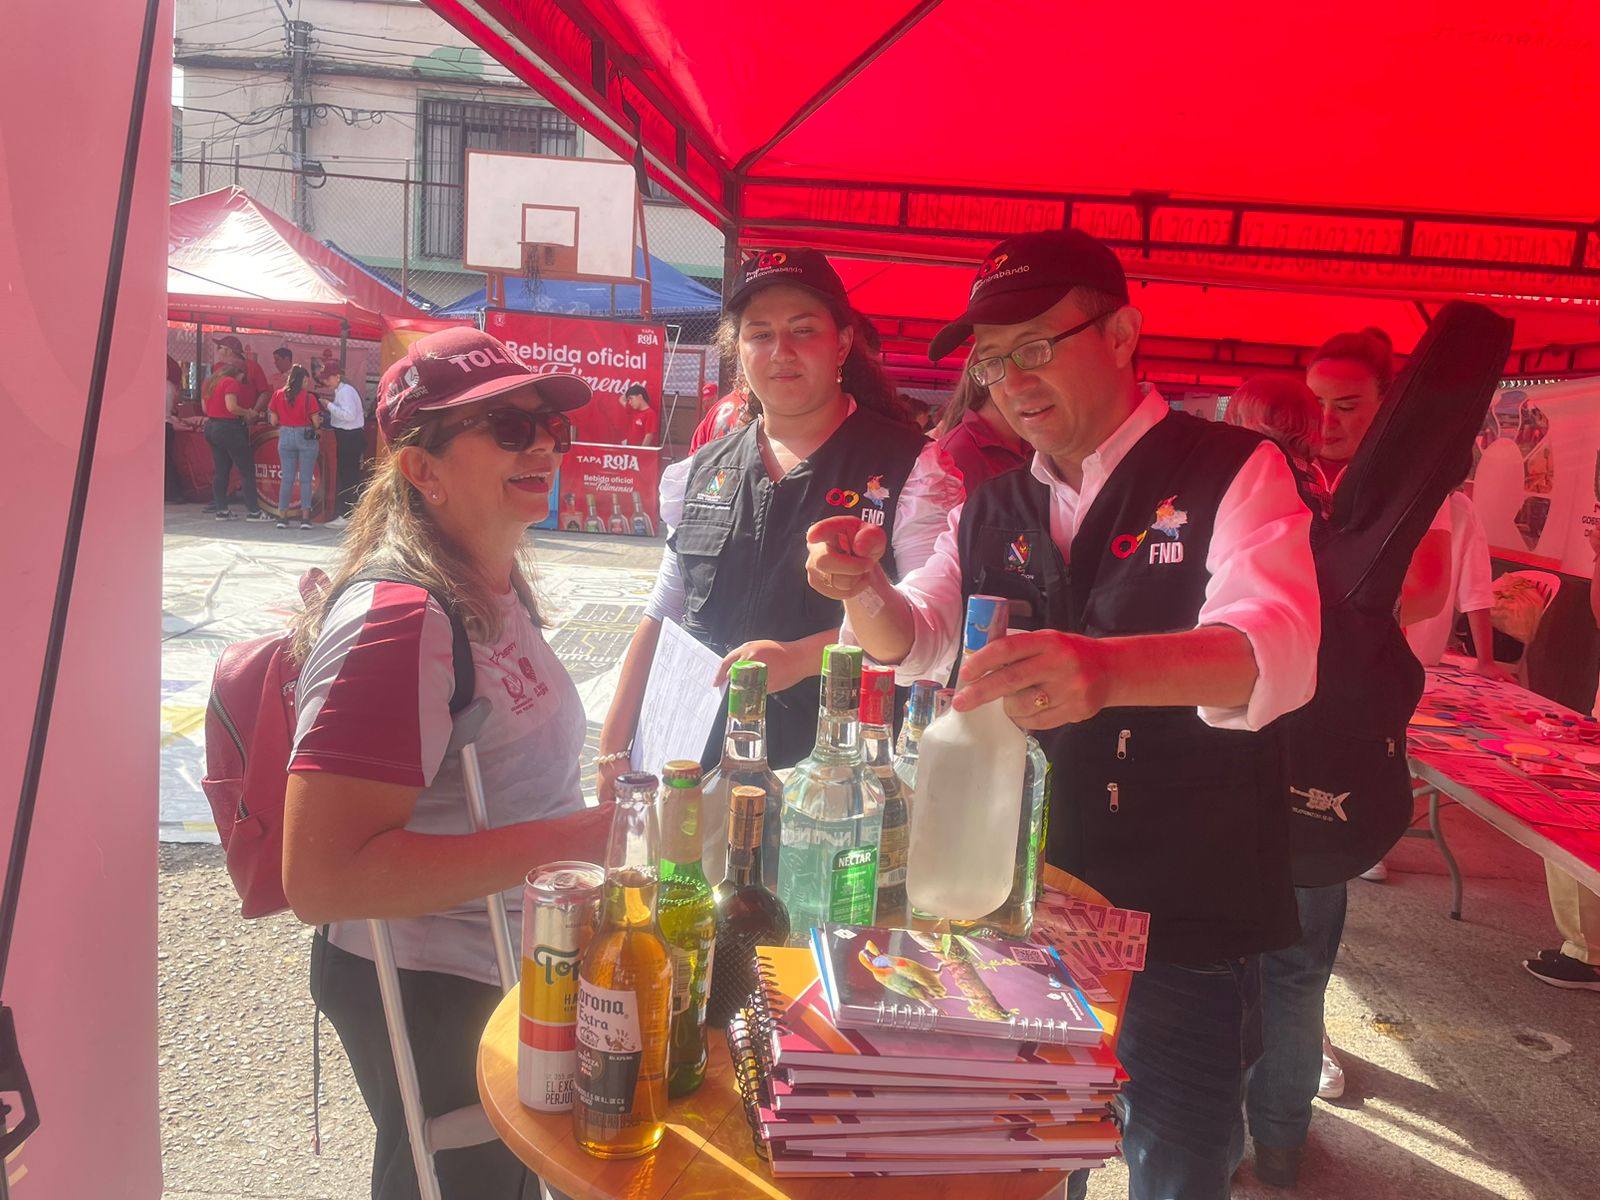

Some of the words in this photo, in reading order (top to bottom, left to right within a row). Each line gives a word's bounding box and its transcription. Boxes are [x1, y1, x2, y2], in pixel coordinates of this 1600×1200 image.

[637, 334, 659, 346] ROJA
[505, 340, 581, 363] Bebida
[587, 345, 647, 370] oficial
[576, 455, 602, 465] TAPA
[602, 453, 640, 471] ROJA
[583, 474, 610, 483] Bebida
[610, 475, 634, 485] oficial
[861, 508, 885, 526] FND
[1149, 541, 1184, 565] FND
[838, 852, 871, 868] NECTAR
[578, 1007, 609, 1030] Extra
[546, 1080, 555, 1093] EL
[558, 1079, 574, 1093] EXC
